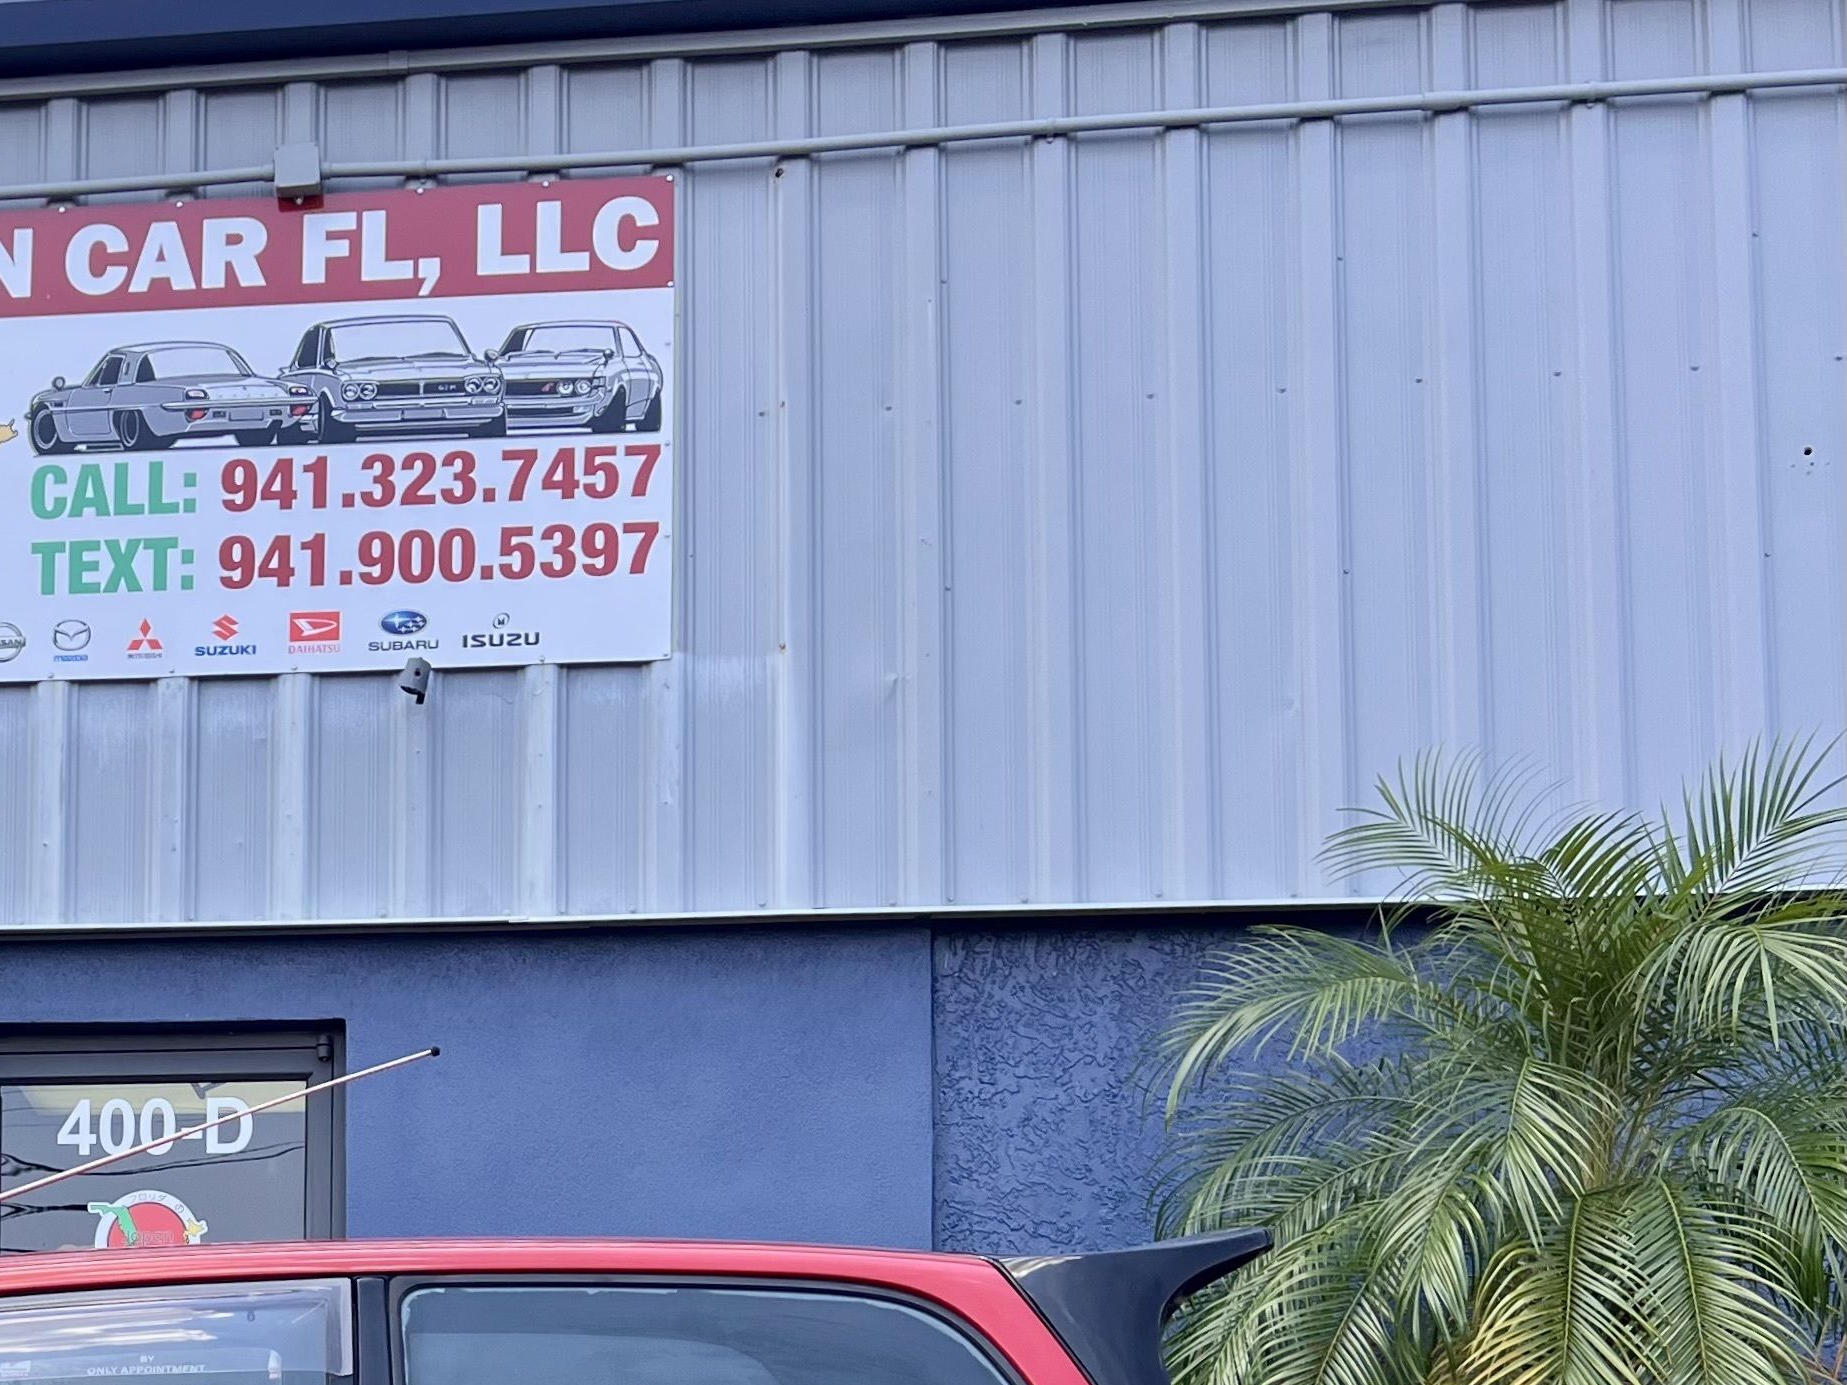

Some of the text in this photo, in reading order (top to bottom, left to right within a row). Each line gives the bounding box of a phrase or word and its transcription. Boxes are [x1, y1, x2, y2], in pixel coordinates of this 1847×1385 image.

[65, 217, 268, 297] CAR
[301, 210, 441, 297] FL,
[476, 196, 660, 277] LLC
[30, 444, 662, 520] CALL: 941.323.7457
[30, 521, 660, 596] TEXT: 941.900.5397
[368, 639, 440, 652] SUBARU
[461, 632, 541, 649] ISUZU
[194, 644, 257, 656] SUZUKI
[288, 644, 341, 655] DAIHATSU
[56, 1096, 255, 1157] 400-D
[140, 1354, 155, 1363] BY
[86, 1364, 206, 1376] ONLY APPOINTMENT
